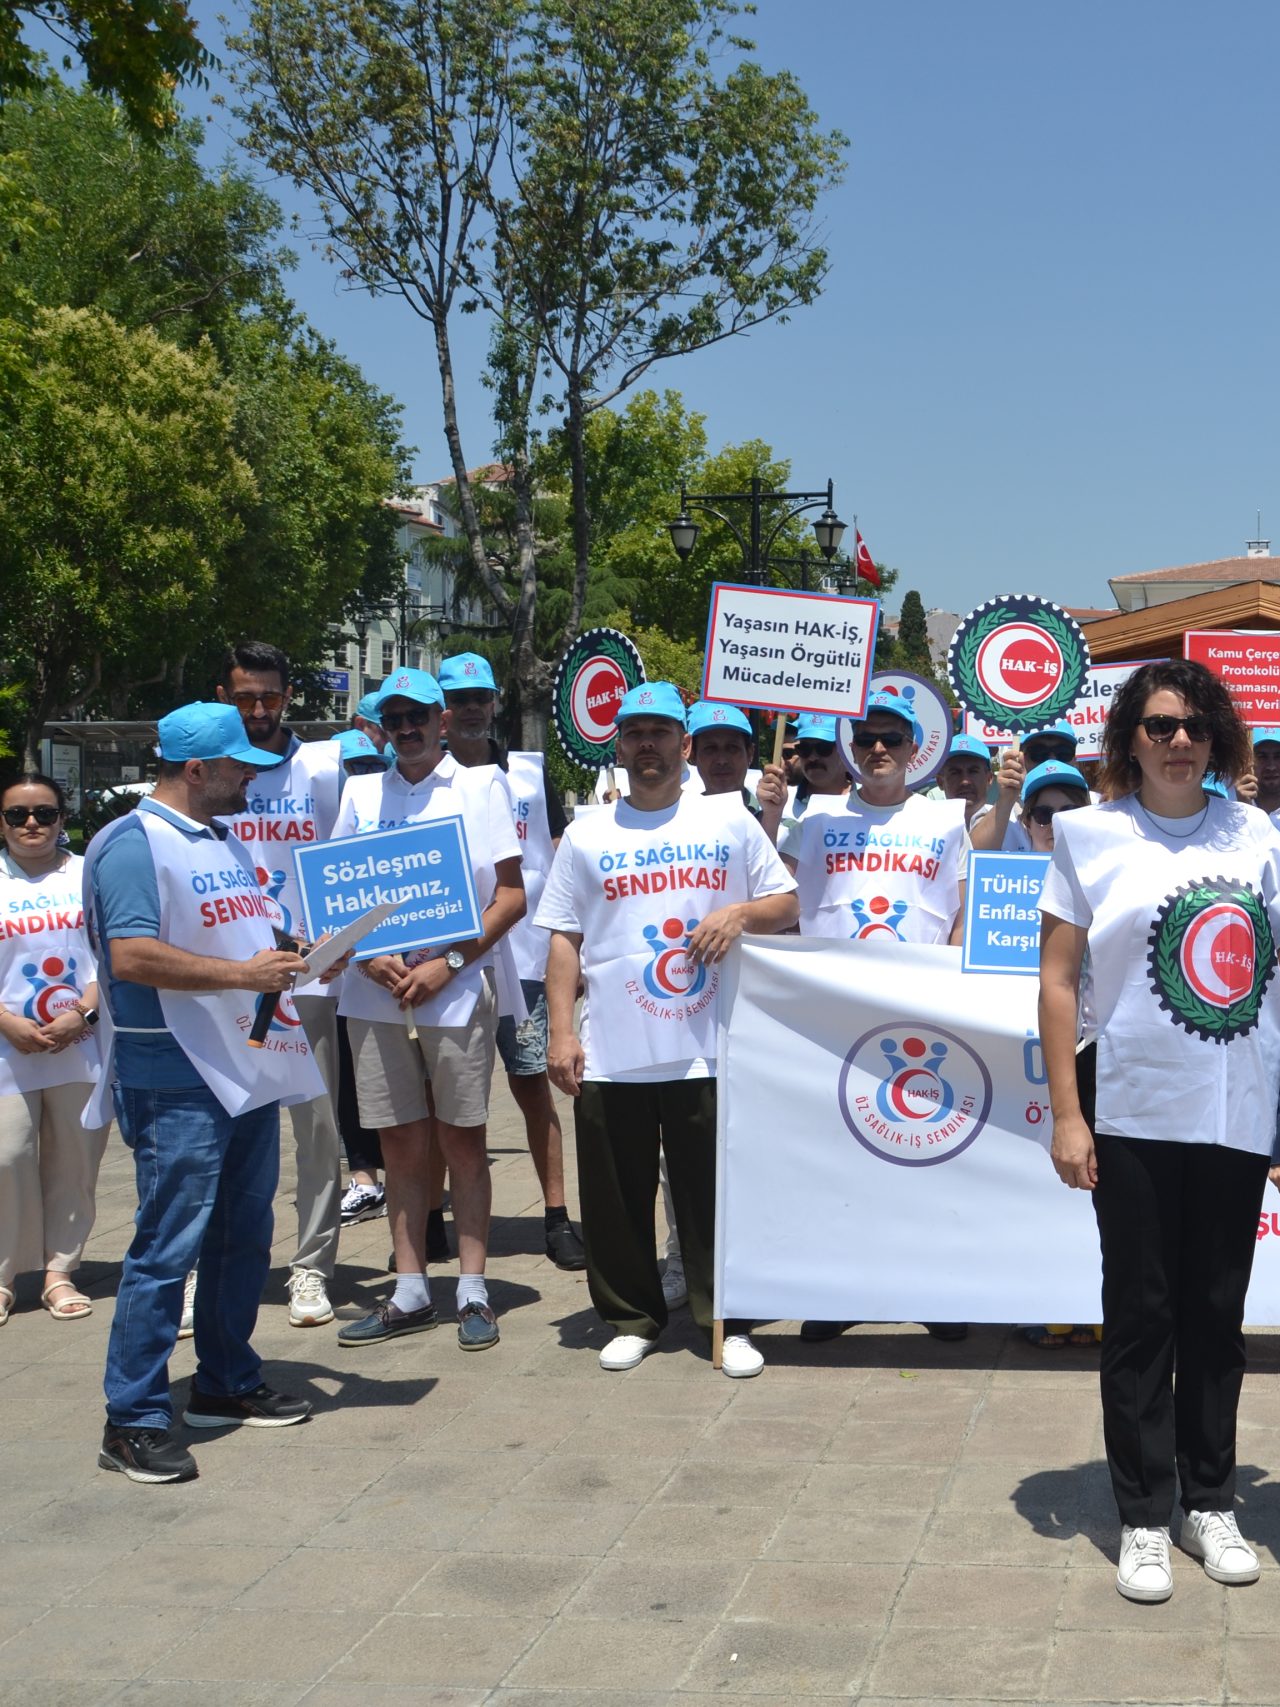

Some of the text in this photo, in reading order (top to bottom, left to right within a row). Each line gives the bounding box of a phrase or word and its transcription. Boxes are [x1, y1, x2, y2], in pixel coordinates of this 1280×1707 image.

[723, 612, 864, 645] Yaşasın HAK-İŞ,
[719, 638, 861, 668] Yaşasın Örgütlü
[1001, 658, 1059, 677] HAK-İŞ
[1208, 648, 1243, 659] Kamu
[722, 665, 851, 693] Mücadelemiz!
[1221, 665, 1280, 676] Protokolü
[906, 730, 941, 774] SENDİKASI
[823, 829, 850, 848] ÖZ
[322, 849, 443, 886] Sözleşme
[600, 839, 730, 872] ÖZ SAĞLIK-İŞ
[825, 849, 941, 881] SENDİKASI
[191, 870, 220, 895] ÖZ
[603, 865, 728, 901] SENDİKASI
[625, 980, 638, 995] ÖZ
[686, 971, 719, 1017] SENDİKASI
[907, 1088, 940, 1101] HAK-İŞ
[855, 1095, 976, 1149] ÖZ SAĞLIK-İŞ SENDİKASI
